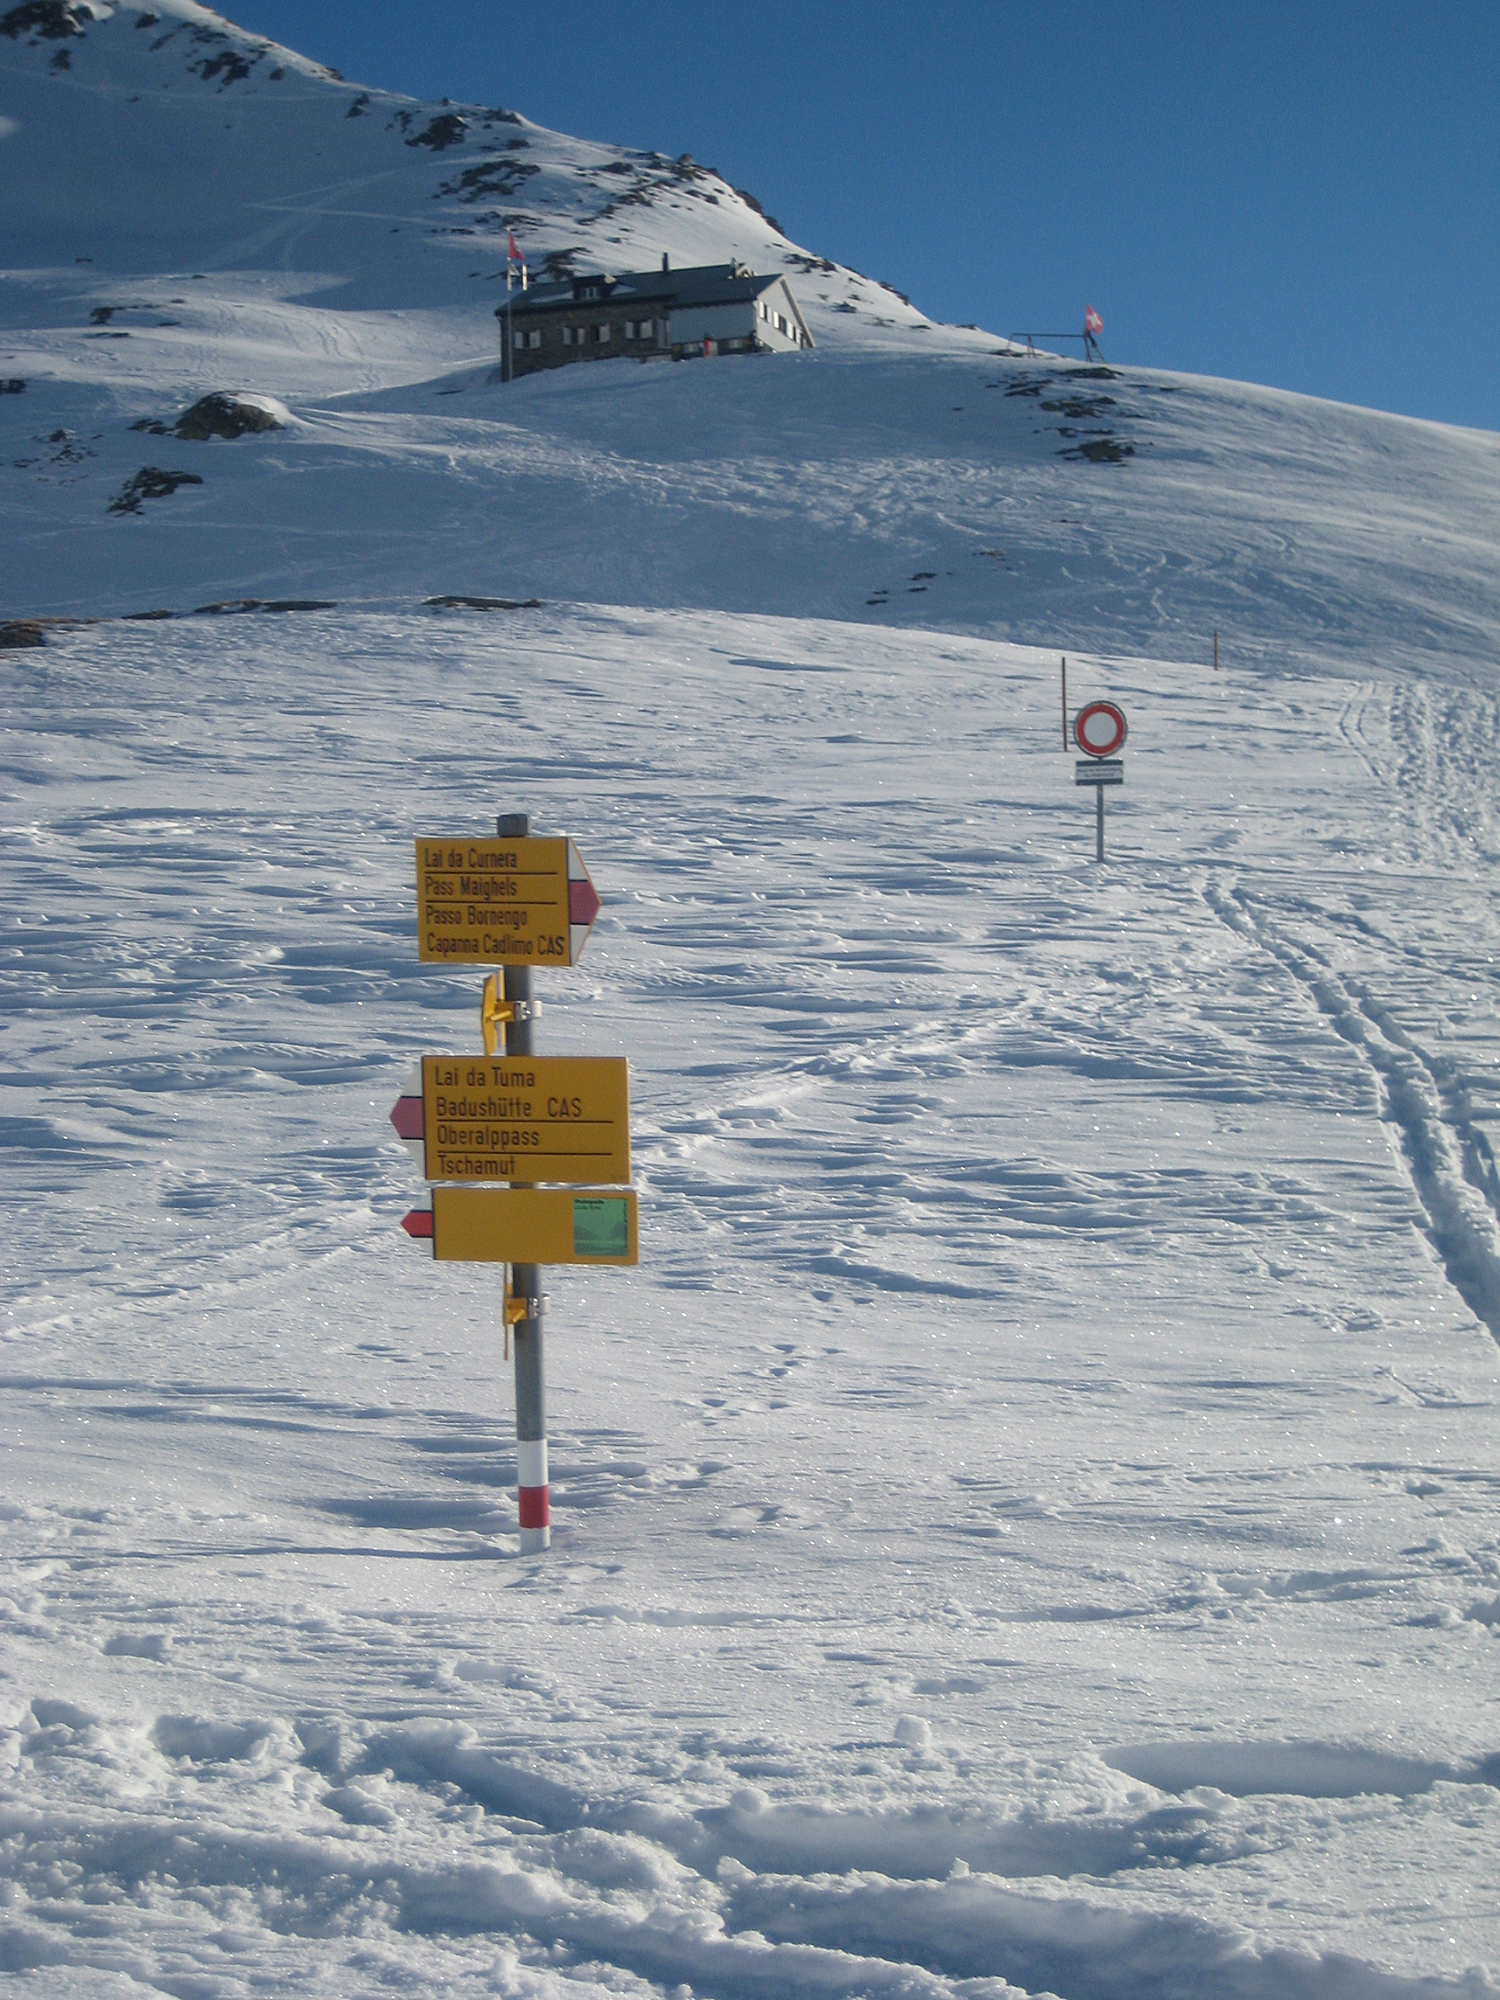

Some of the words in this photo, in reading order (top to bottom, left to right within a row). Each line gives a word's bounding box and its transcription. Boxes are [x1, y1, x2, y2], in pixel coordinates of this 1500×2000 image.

[424, 848, 443, 868] Lai
[447, 848, 463, 868] da
[467, 848, 518, 869] Curnera
[424, 876, 454, 896] Pass
[459, 876, 518, 900] Maighels
[425, 905, 462, 925] Passo
[466, 905, 528, 930] Bornengo
[426, 932, 480, 958] Capanna
[482, 933, 533, 955] Cadlimo
[536, 935, 566, 956] CAS
[434, 1066, 459, 1086] Lai
[466, 1066, 486, 1087] da
[491, 1066, 536, 1087] Tuma
[435, 1096, 532, 1117] Badushütte
[546, 1097, 583, 1118] CAS
[436, 1124, 540, 1151] Oberalppass
[437, 1154, 516, 1176] Tschamut
